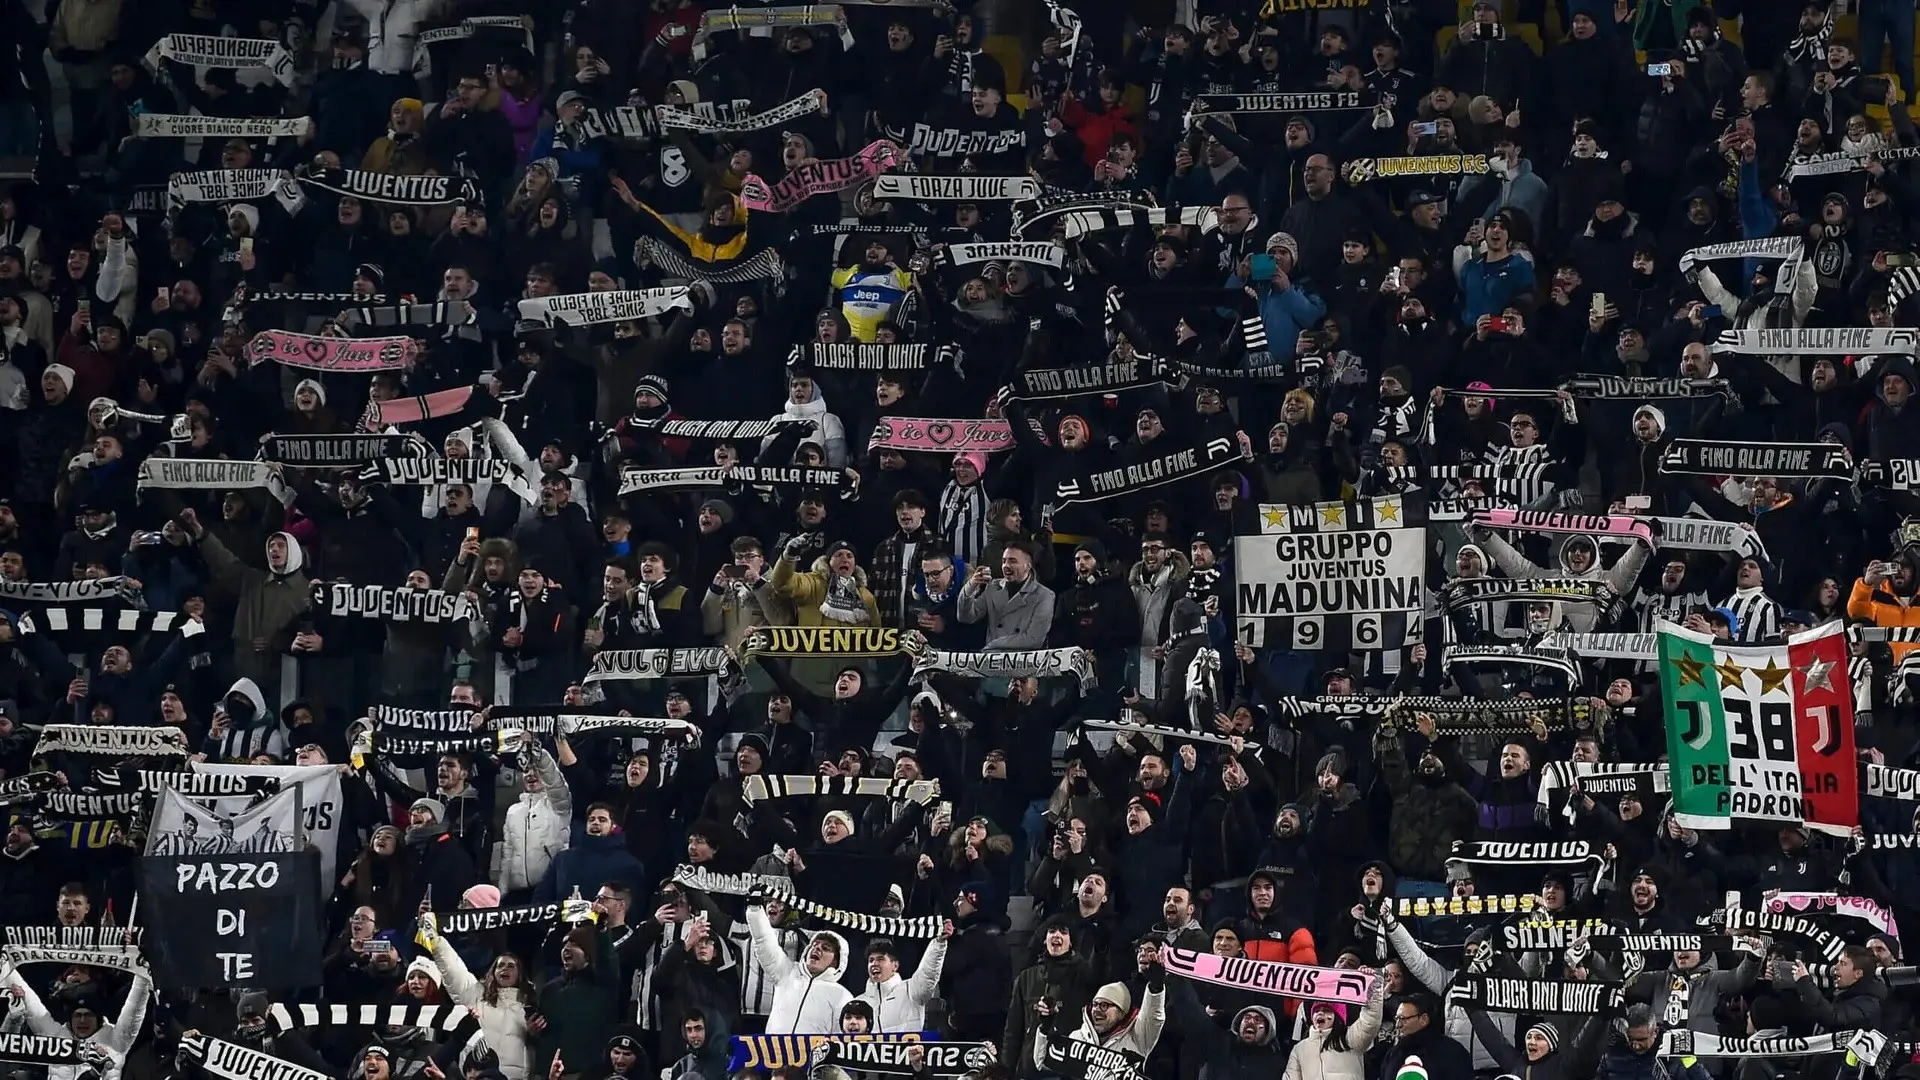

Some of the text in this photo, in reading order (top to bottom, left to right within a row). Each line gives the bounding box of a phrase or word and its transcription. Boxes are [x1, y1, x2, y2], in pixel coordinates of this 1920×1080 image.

[424, 28, 457, 40] ENTUS
[1236, 94, 1360, 111] JUVENTUS FC
[171, 125, 273, 135] CUORE BIANCO NERO
[1376, 156, 1461, 175] JUVENTUS
[344, 170, 449, 200] JUVENTUS
[771, 156, 864, 203] JUVENTUS
[911, 177, 1009, 198] FORZA JUVE
[853, 290, 880, 302] Jeep
[1758, 328, 1871, 349] FINO ALLA FINE
[327, 343, 373, 365] Juve
[814, 343, 927, 369] BLACK AND WHITE
[1025, 359, 1138, 393] FINO ALLA FINE
[1597, 378, 1692, 397] JUVENTUS
[705, 421, 734, 439] AND
[900, 419, 1012, 447] io Juve
[276, 439, 388, 460] FINO ALLA FINE
[1701, 450, 1810, 471] FINO ALLA FINE
[163, 462, 256, 482] FINO ALLA FINE
[389, 459, 507, 484] JUVENTUS
[631, 470, 722, 486] FORZA JU
[760, 467, 801, 483] ALLA
[806, 469, 839, 485] FINE
[1090, 450, 1198, 494] FINO ALLA FINE
[1292, 502, 1364, 527] M I
[1430, 496, 1508, 514] VENTUS
[1511, 510, 1611, 529] JUVENTUS
[1699, 522, 1735, 545] FINE
[1276, 531, 1392, 562] GRUPPO
[1286, 558, 1387, 580] JUVENTUS
[1239, 576, 1420, 614] MADUNINA
[1473, 579, 1590, 598] JUVENTUS
[331, 583, 454, 622] JUVENTUS
[1652, 607, 1680, 618] Jeep
[769, 628, 898, 651] JUVENTUS
[946, 650, 1061, 670] JUVENTUS
[1316, 695, 1367, 704] GRUPPO
[377, 704, 472, 732] JUVENTUS
[58, 729, 164, 750] JUVENTUS
[1723, 697, 1796, 763] 38
[378, 736, 492, 755] JUVENTUS
[137, 770, 247, 794] JUVENTUS
[1583, 777, 1637, 793] JUVENTUS
[45, 791, 144, 816] JUVENTUS
[1717, 791, 1816, 822] PADRONI
[1476, 840, 1590, 859] JUVENTUS
[175, 861, 280, 894] PAZZO
[1399, 893, 1535, 916] JUVENTUS
[216, 908, 246, 937] DI
[443, 904, 559, 934] JUVENTUS
[1621, 935, 1701, 951] JUVENTUS
[11, 951, 130, 968] BIANCONERA
[215, 952, 255, 982] TE
[1214, 956, 1319, 994] JUVENTUS
[1487, 976, 1605, 1013] BLACK AND WHITE
[1069, 1040, 1086, 1061] DI
[1717, 1035, 1808, 1054] JUVENTUS
[211, 1041, 320, 1080] JUVENTUS
